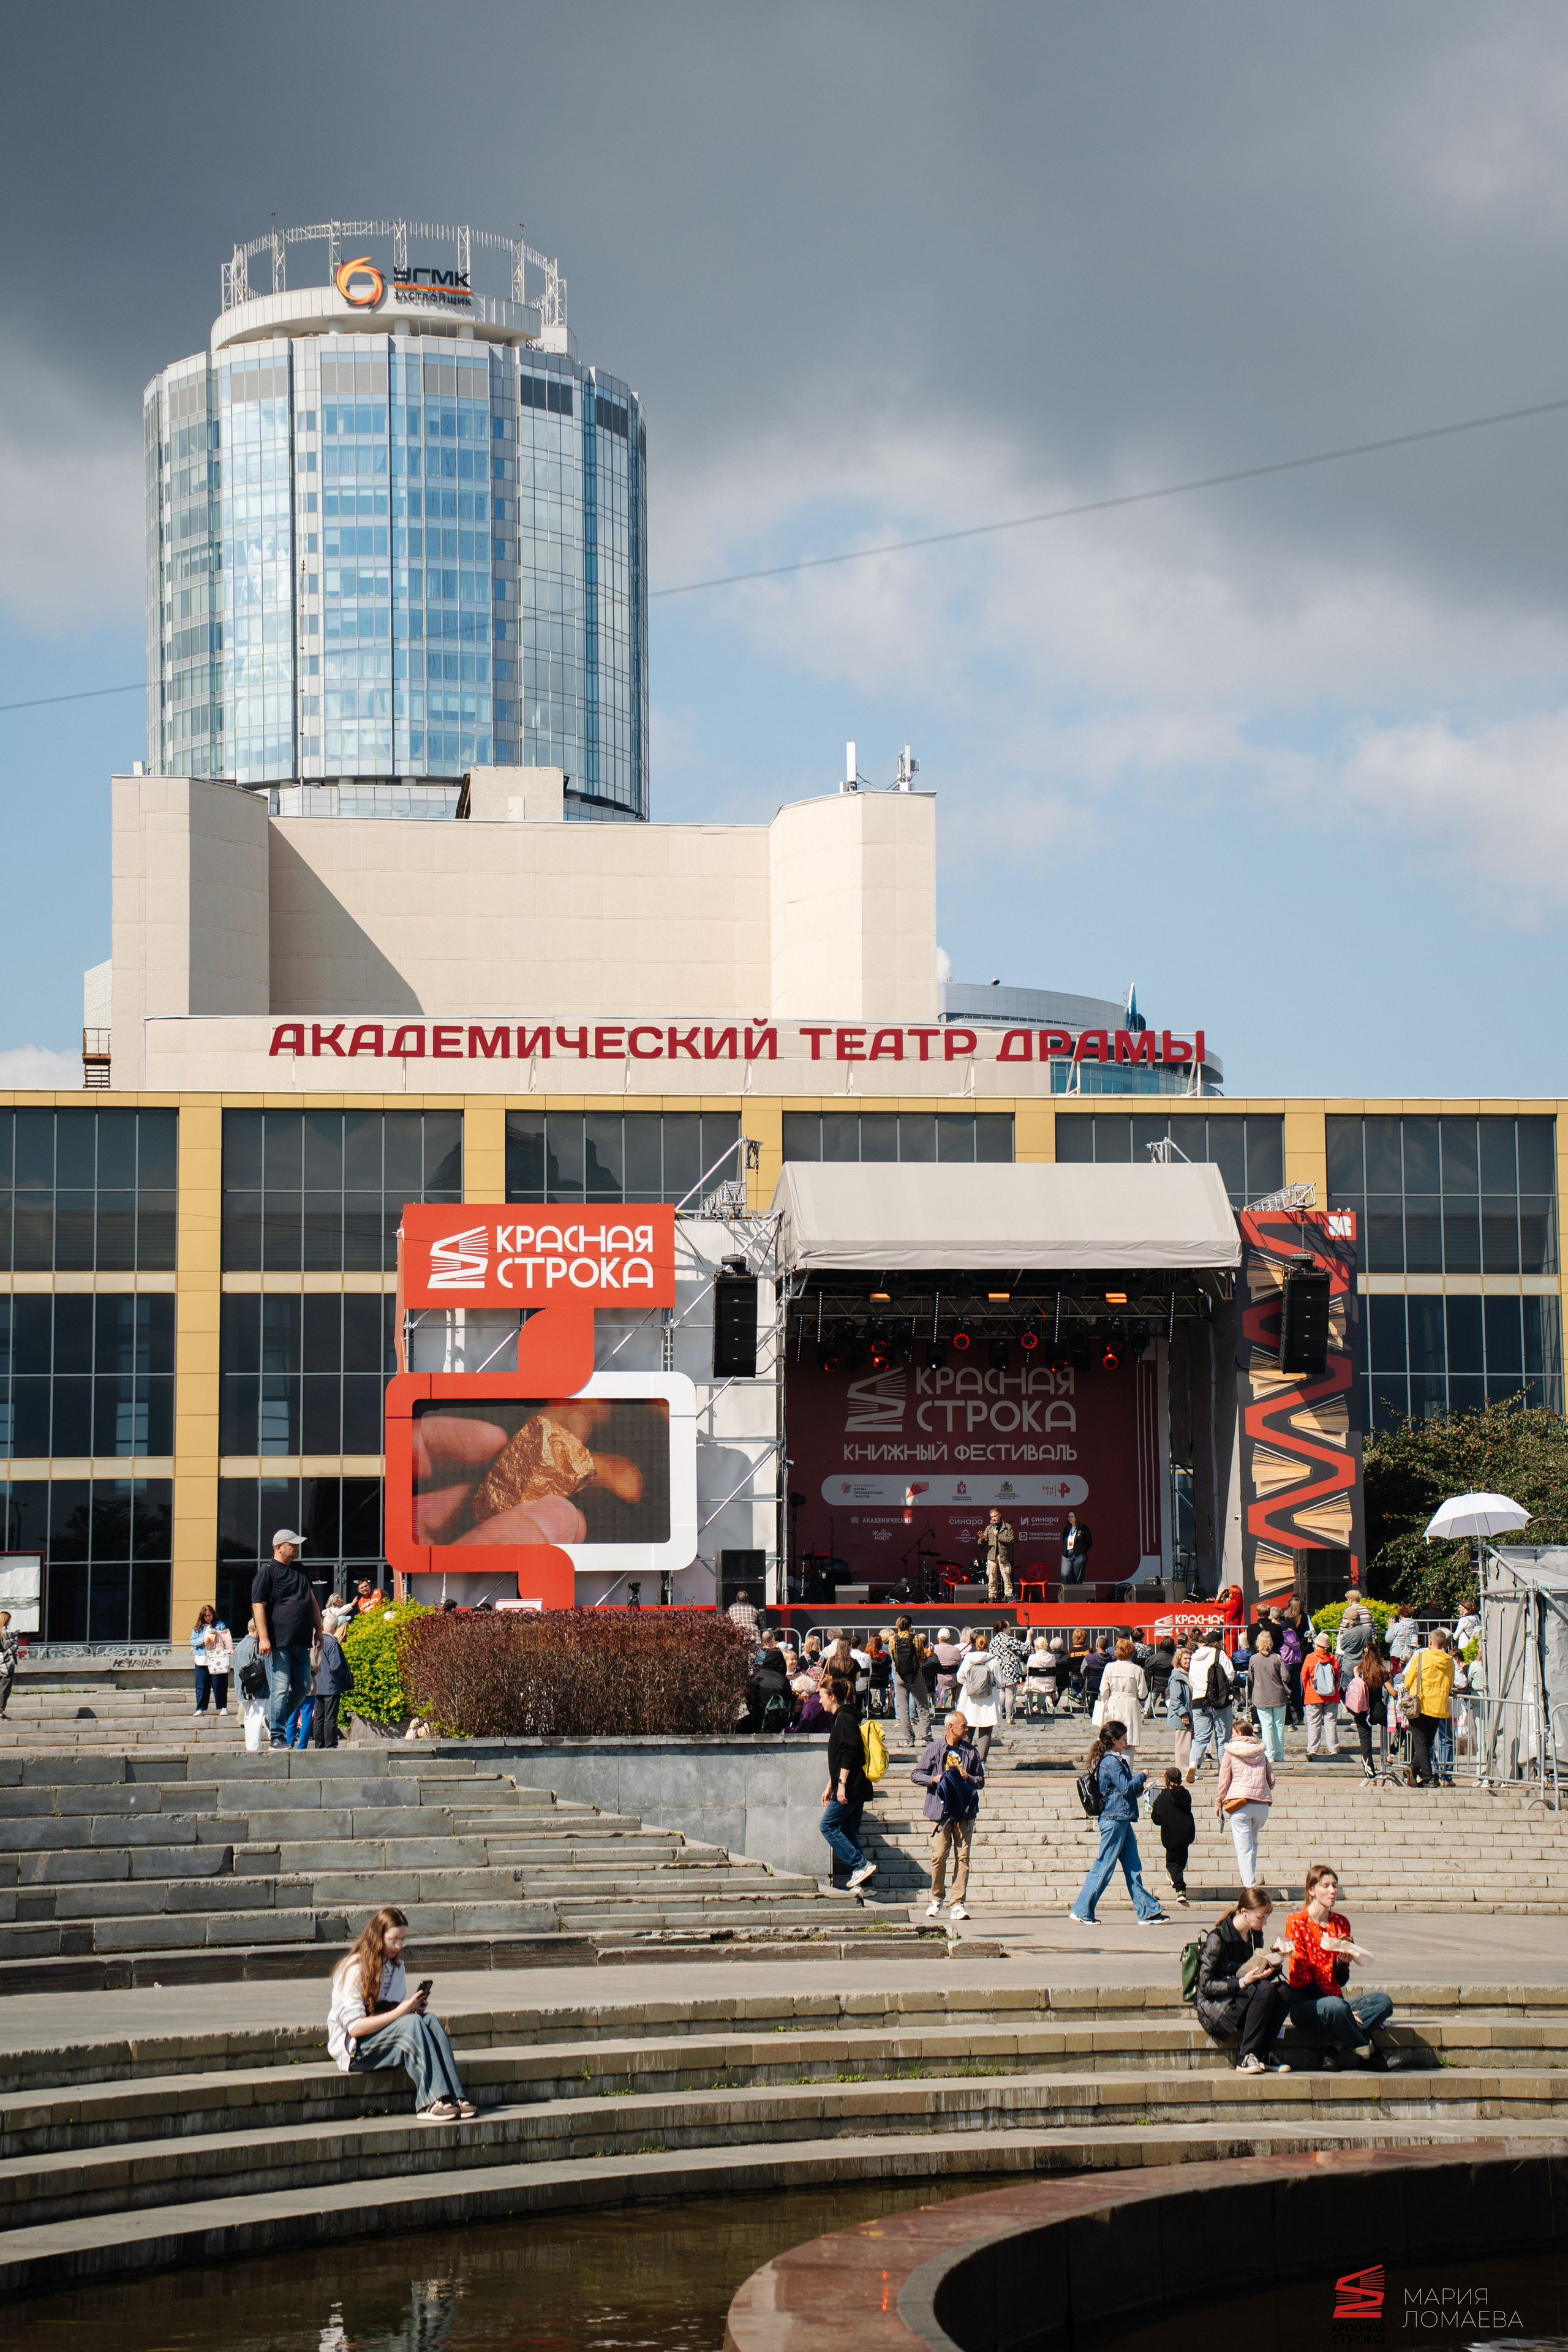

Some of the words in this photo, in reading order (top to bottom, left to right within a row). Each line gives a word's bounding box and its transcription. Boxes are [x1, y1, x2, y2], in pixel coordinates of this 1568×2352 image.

[393, 267, 470, 287] УГМК
[394, 291, 472, 306] ЗАСТРОЙЩИК
[269, 1018, 777, 1060] АКАДЕМИЧЕСКИЙ
[799, 1028, 978, 1061] ТЕАТР
[996, 1030, 1205, 1063] ДРАМЫ
[497, 1225, 653, 1253] КРАСНАЯ
[497, 1257, 654, 1288] СТРОКА
[916, 1366, 1074, 1395] КРАСНАЯ
[916, 1400, 1076, 1432] СТРОКА
[843, 1441, 948, 1461] КНИЖНЫЙ
[954, 1444, 1077, 1461] ФЕСТИВАЛЬ
